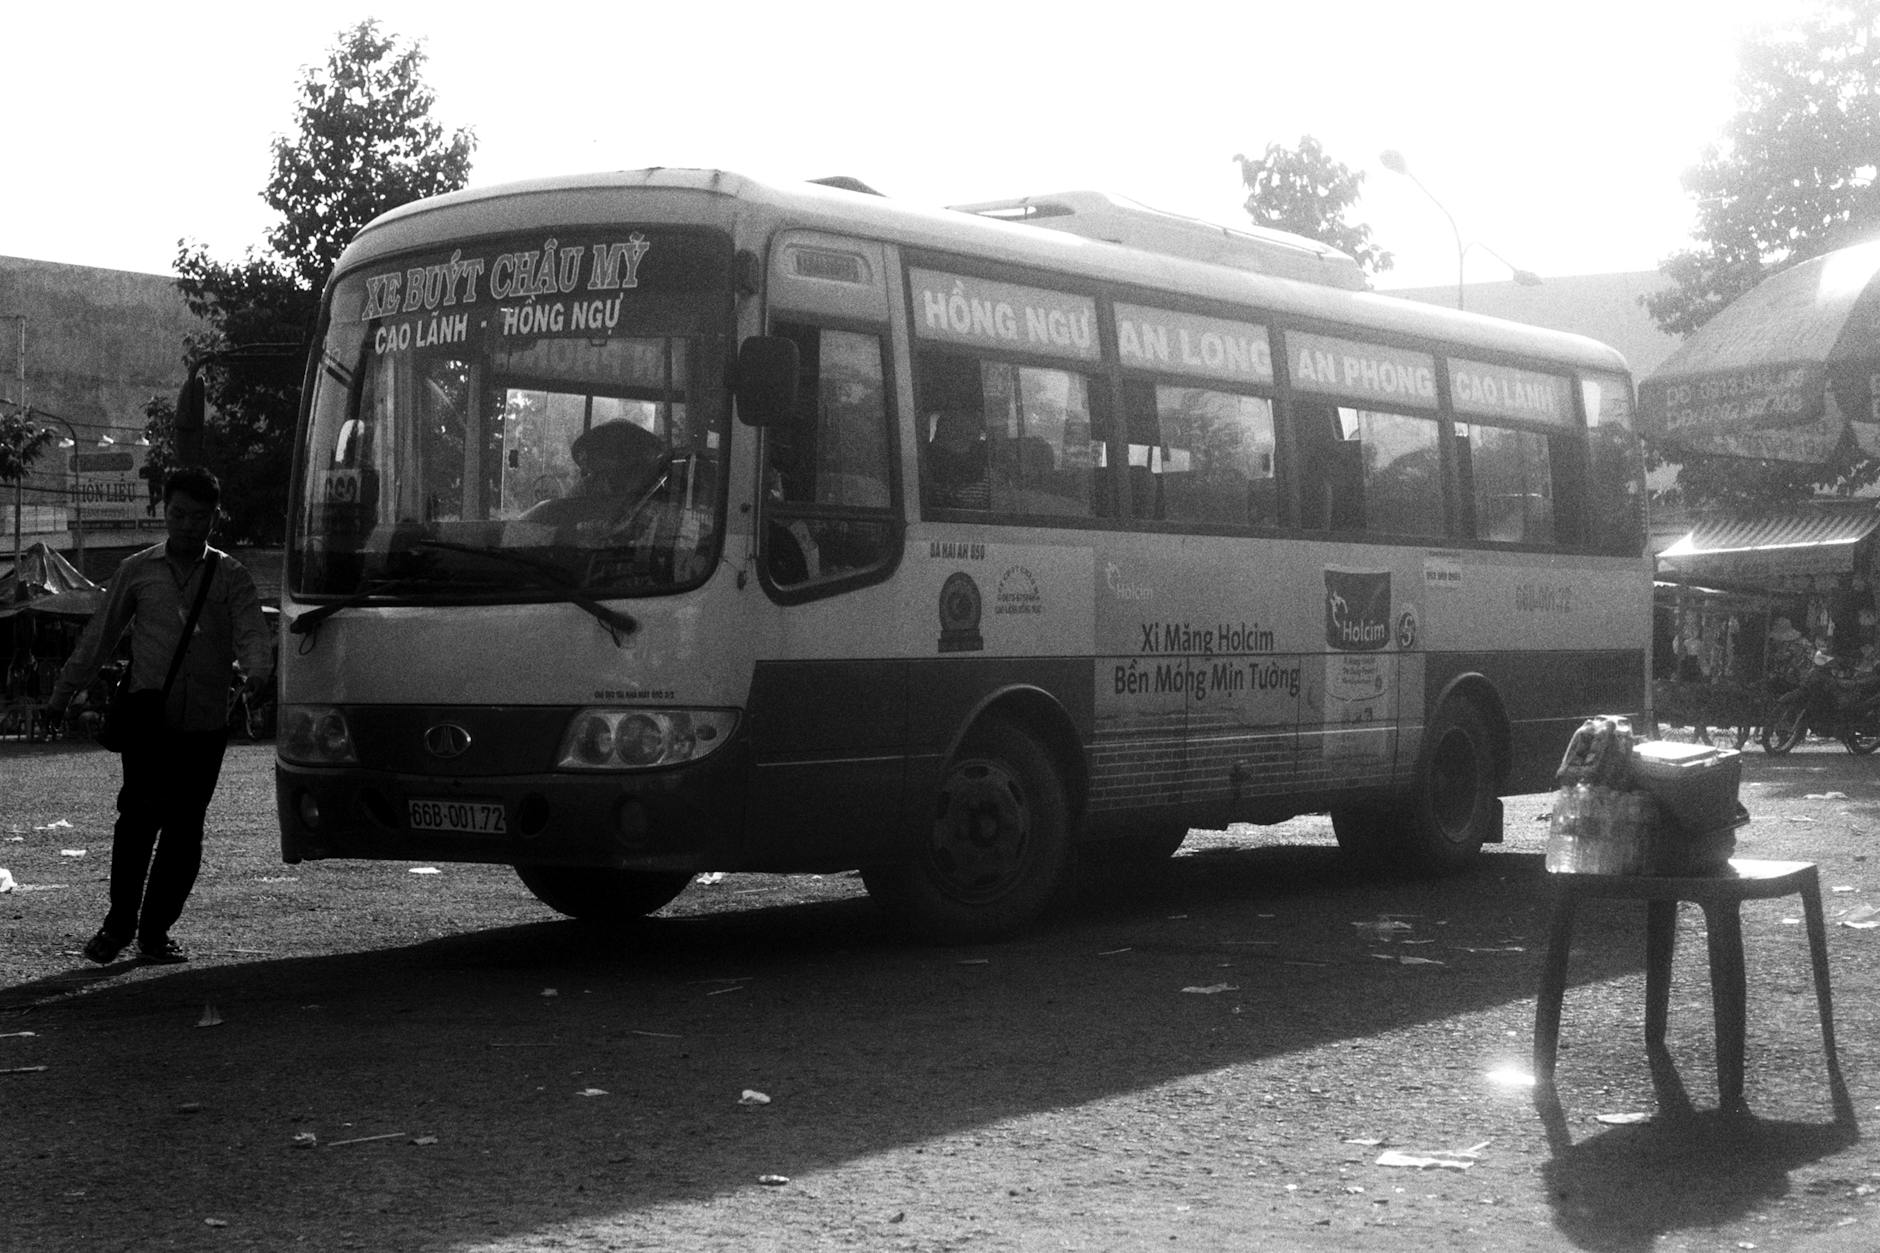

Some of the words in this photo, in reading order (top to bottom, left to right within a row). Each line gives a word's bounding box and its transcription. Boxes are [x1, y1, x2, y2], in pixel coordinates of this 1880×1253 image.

[362, 271, 402, 320] XE
[402, 249, 484, 313] BUÝT
[489, 238, 585, 299] CHÂU
[588, 231, 651, 290] MỸ
[375, 325, 410, 355] CAO
[416, 311, 468, 348] LÃNH
[503, 294, 564, 336] HỒNG
[571, 292, 625, 337] NGỰ
[924, 279, 1018, 340] HỒNG
[1025, 305, 1091, 357] NGỰ
[1118, 320, 1169, 362] AN
[1179, 328, 1274, 376] LONG
[1299, 350, 1337, 383] AN
[1456, 371, 1496, 402] CAO
[1117, 583, 1153, 600] Holcim
[1141, 622, 1159, 652] Xi
[1165, 622, 1214, 662] Măng
[1218, 622, 1274, 653] Holcim
[1342, 620, 1386, 643] Holcim
[1115, 658, 1149, 695] Bền
[1155, 660, 1207, 700] Móng
[1211, 660, 1244, 698] Mịn
[1250, 657, 1300, 697] Tường
